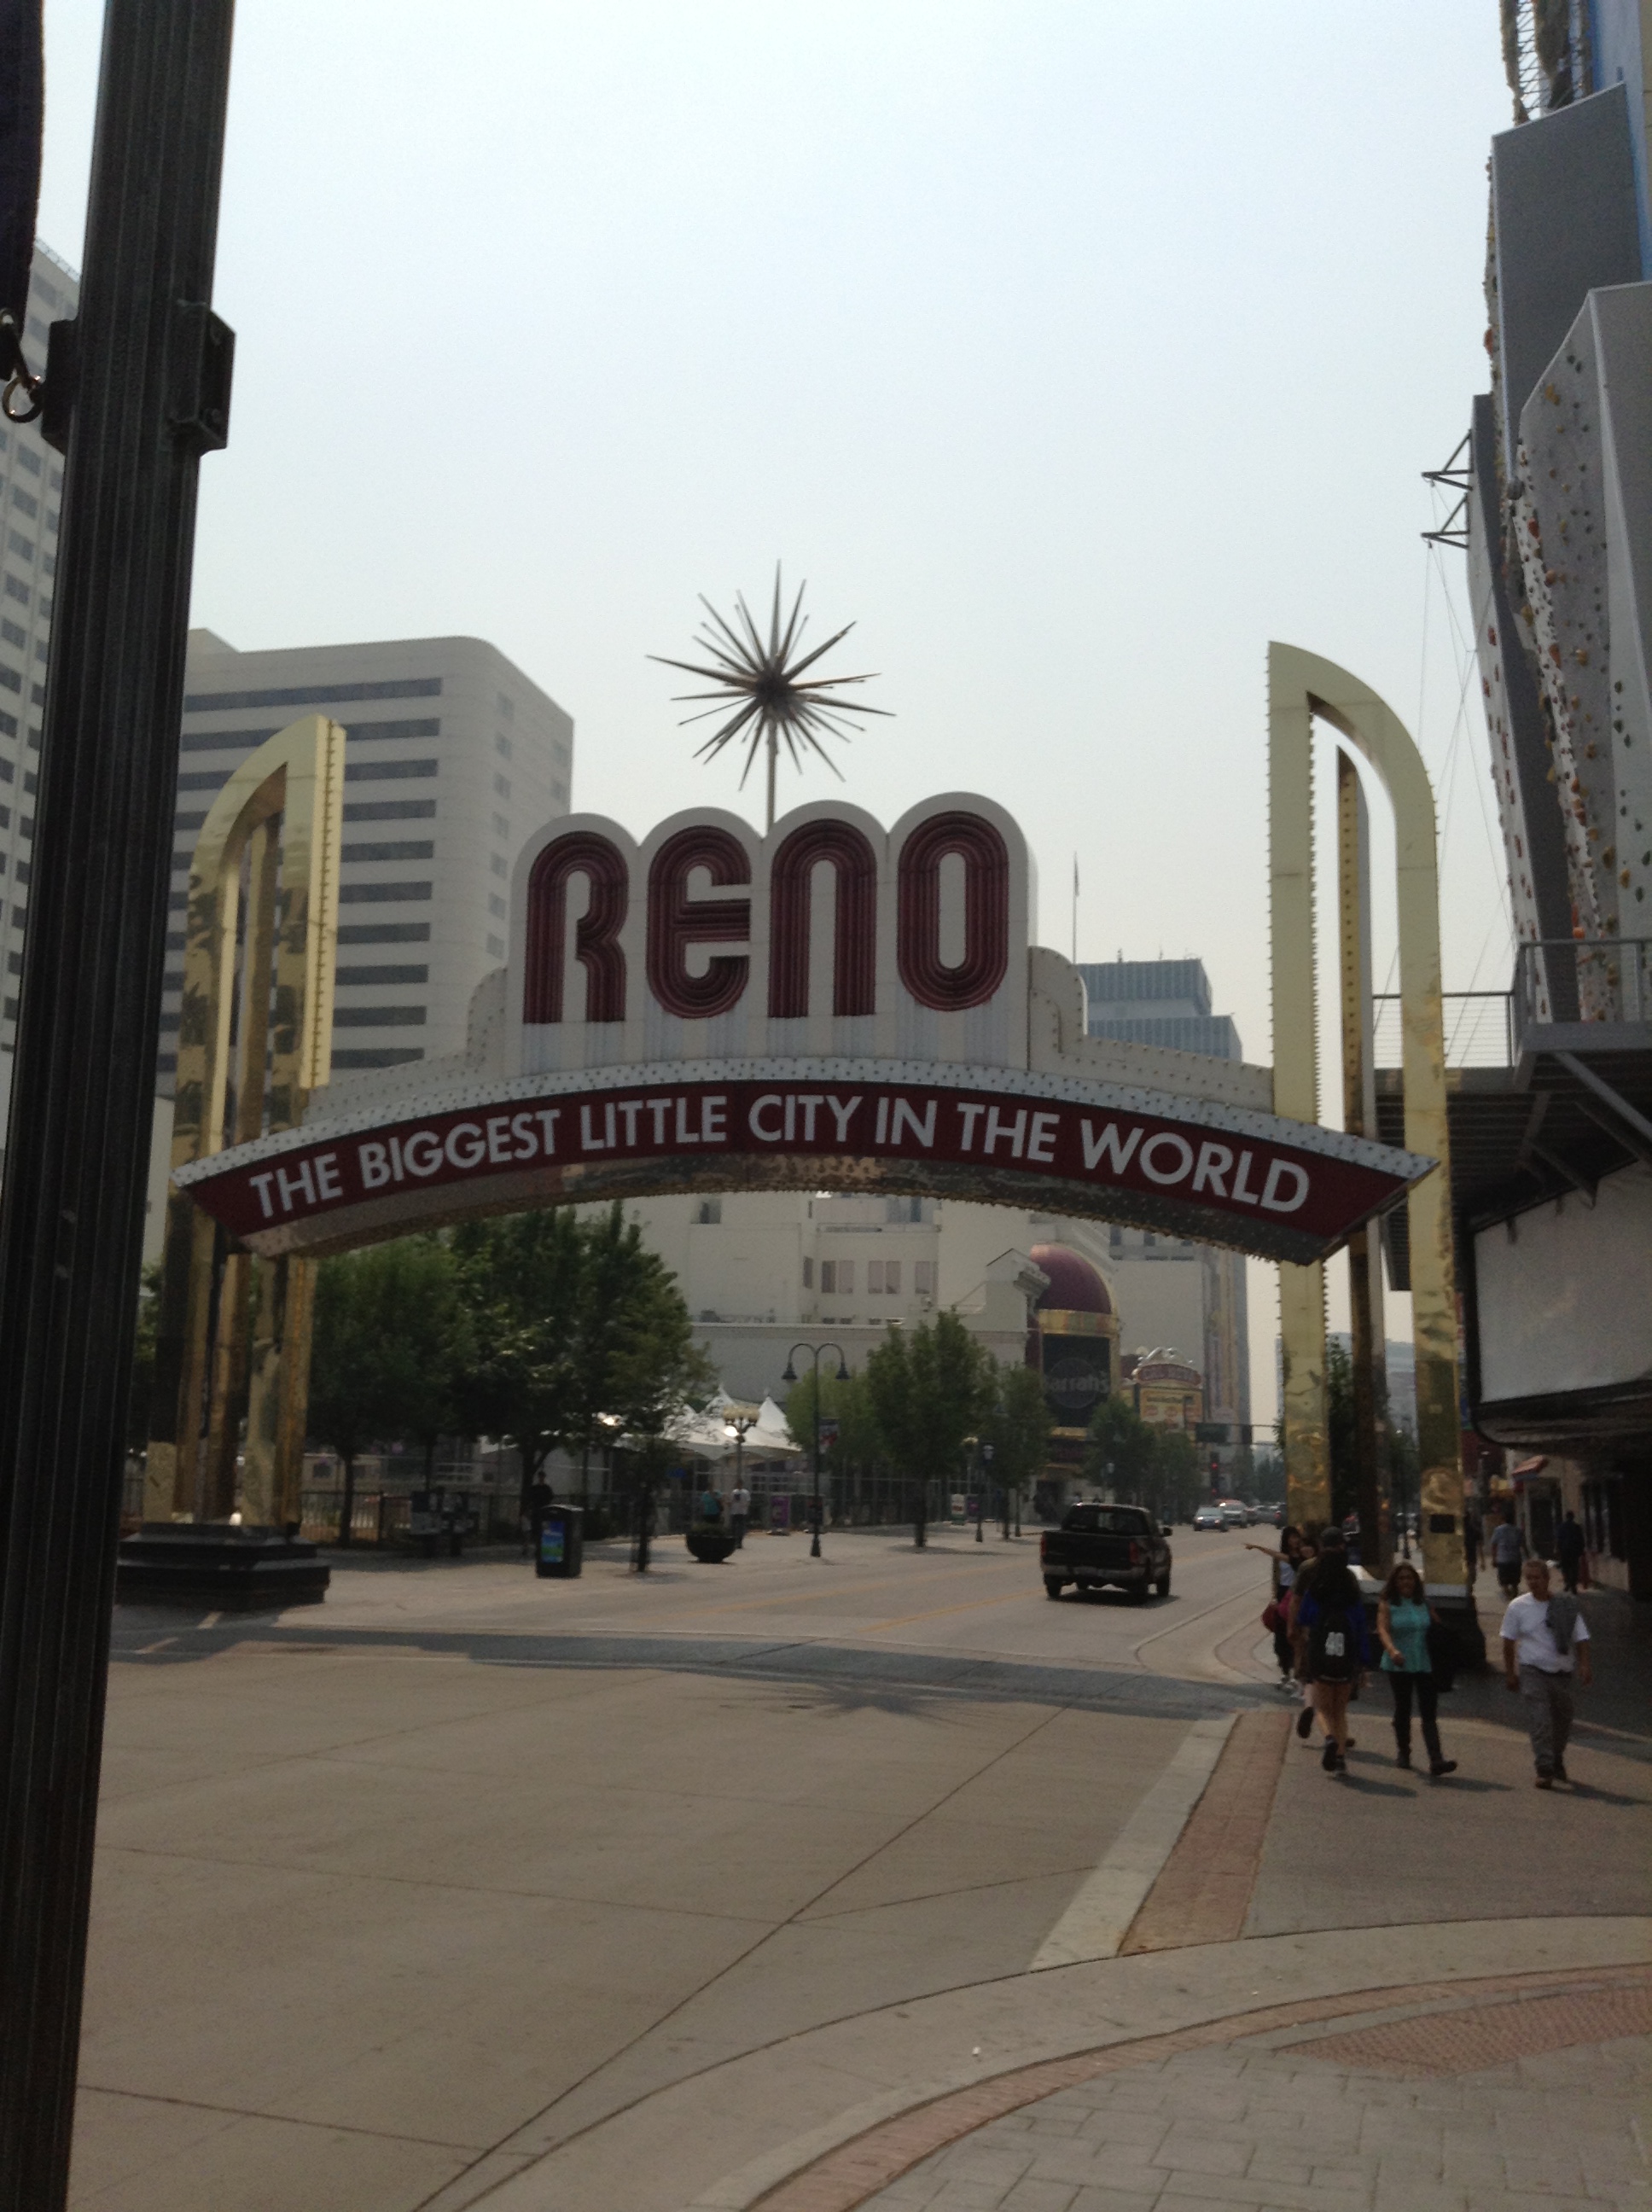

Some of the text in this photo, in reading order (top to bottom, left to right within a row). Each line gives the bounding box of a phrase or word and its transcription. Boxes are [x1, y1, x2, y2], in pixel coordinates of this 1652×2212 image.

[522, 810, 1009, 1023] RENO
[249, 1094, 1311, 1218] THE BIGGEST LITTLE CITY IN THE WORLD
